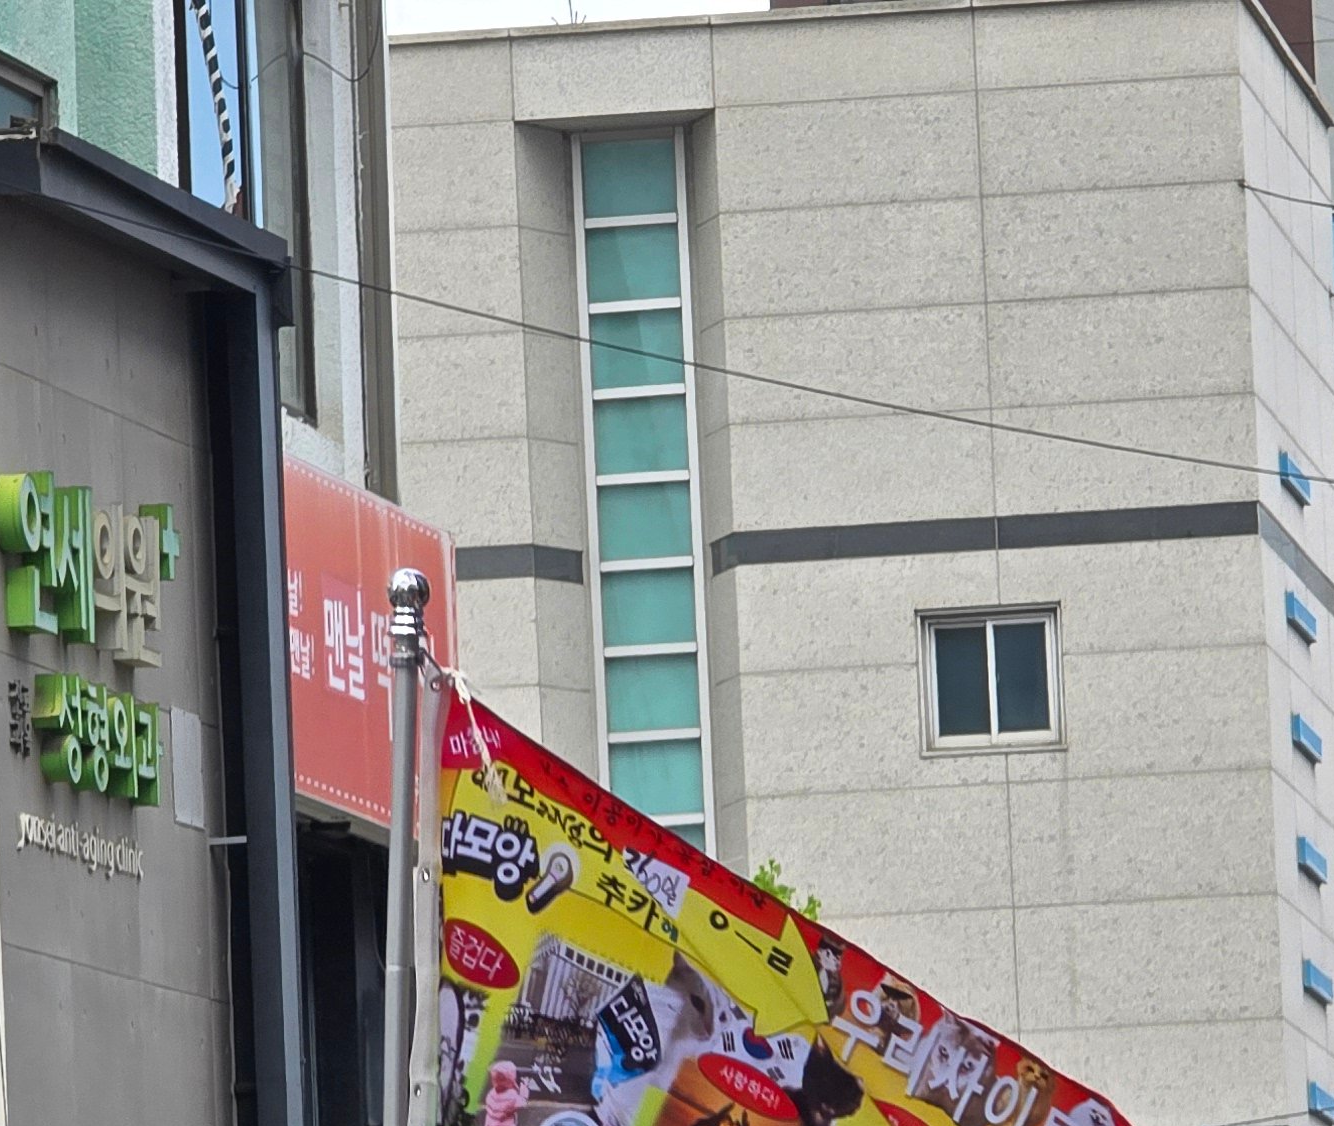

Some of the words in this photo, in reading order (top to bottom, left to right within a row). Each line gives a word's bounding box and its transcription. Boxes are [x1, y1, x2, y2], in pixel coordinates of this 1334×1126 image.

[324, 590, 366, 702] 맨날
[43, 673, 163, 804] 성형외과
[17, 812, 56, 851] yonsei
[57, 822, 115, 880] anti-aging
[116, 837, 145, 880] clinic
[442, 811, 536, 886] 다모앙
[450, 925, 505, 981] 즐겁다
[609, 995, 657, 1062] 다모앙
[720, 1065, 781, 1110] 사랑하다!
